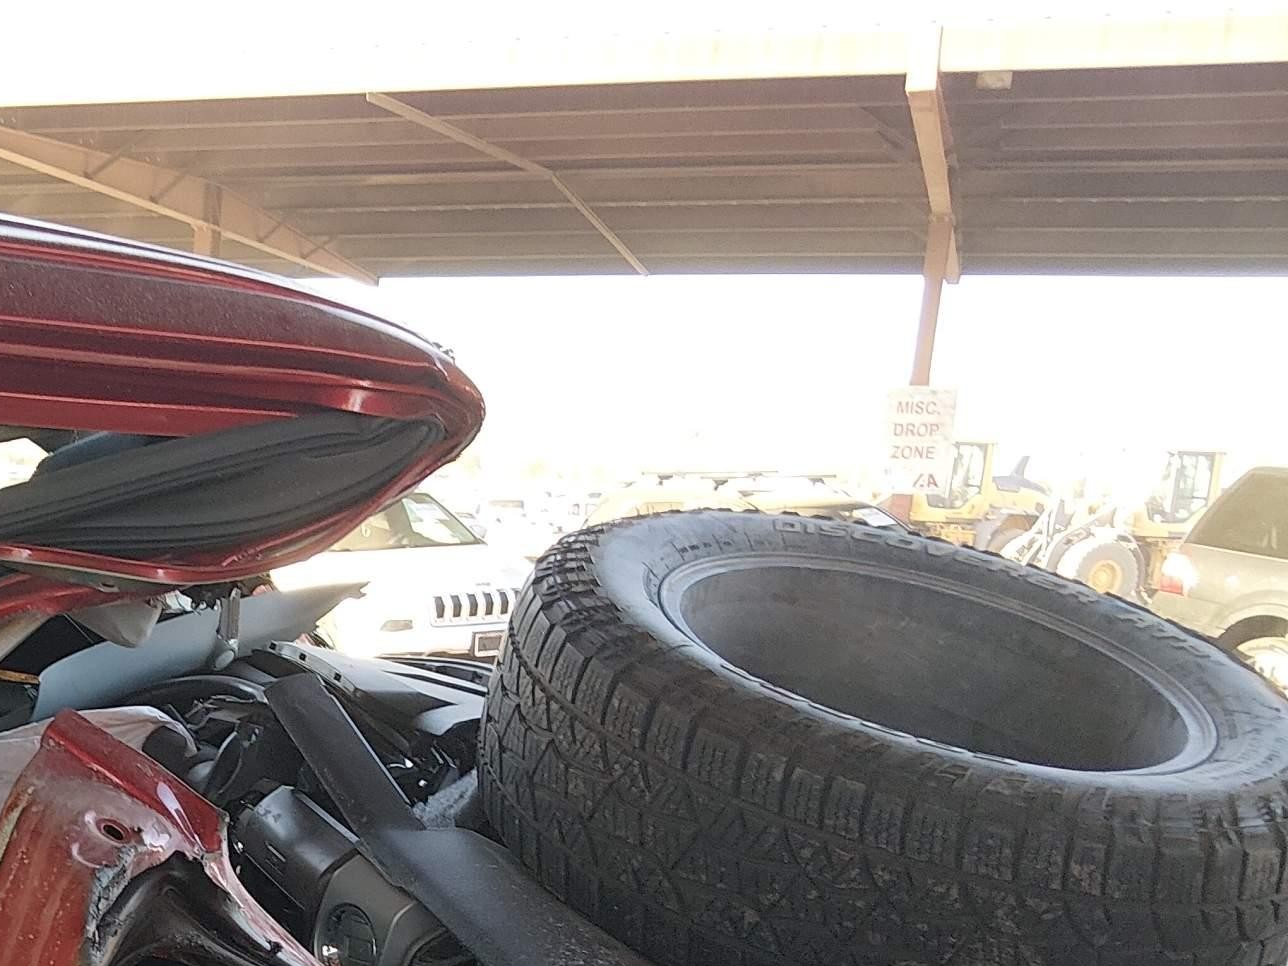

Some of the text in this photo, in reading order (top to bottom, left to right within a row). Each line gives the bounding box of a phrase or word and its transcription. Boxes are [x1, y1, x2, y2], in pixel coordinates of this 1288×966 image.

[897, 400, 941, 416] MISC.
[893, 422, 940, 437] DROP
[889, 445, 937, 460] ZONE
[772, 518, 1100, 604] DISCOVERER
